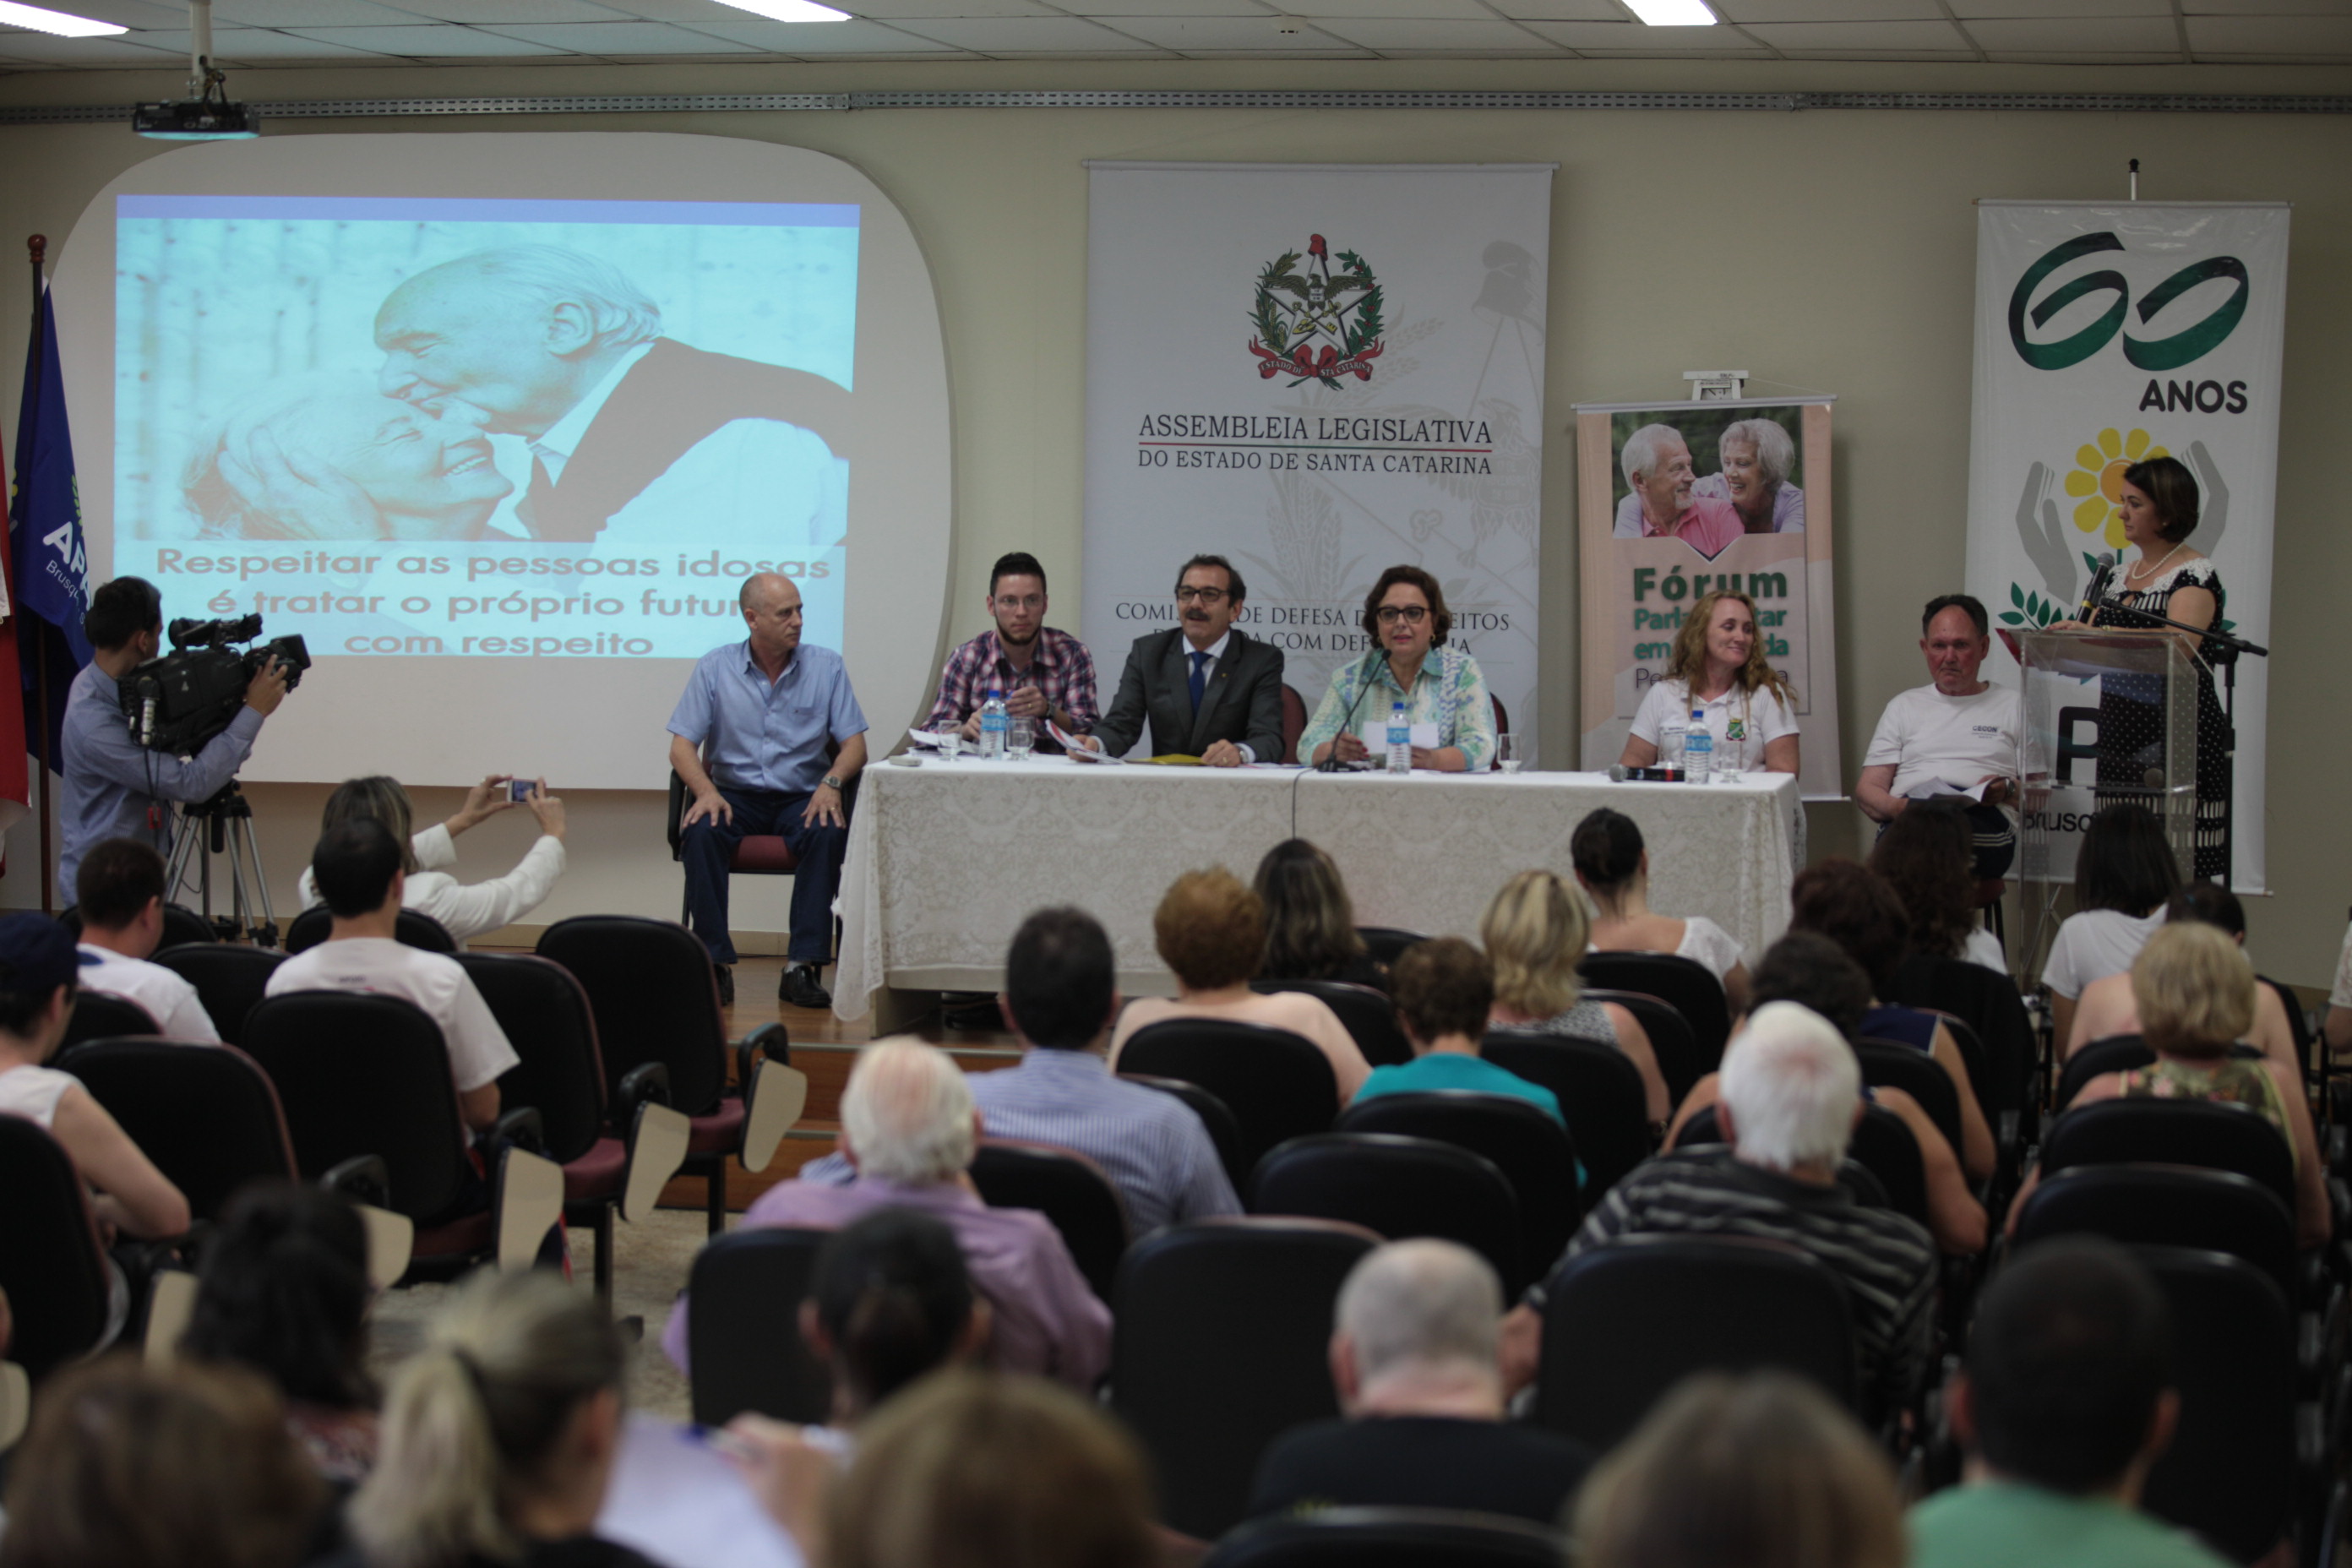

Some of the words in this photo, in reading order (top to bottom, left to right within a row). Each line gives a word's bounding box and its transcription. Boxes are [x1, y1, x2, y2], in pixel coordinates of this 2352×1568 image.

[2138, 378, 2247, 414] ANOS
[1139, 414, 1309, 439] ASSEMBLEIA
[1318, 417, 1492, 444] LEGISLATIVA
[1138, 449, 1168, 467] DO
[1176, 450, 1261, 469] ESTADO
[1270, 452, 1298, 470] DE
[1306, 453, 1375, 471] SANTA
[1383, 455, 1492, 475] CATARINA
[157, 548, 381, 581] Respeitar
[396, 556, 451, 574] as
[467, 554, 660, 581] pessoas
[678, 549, 830, 579] idosas
[1634, 565, 1787, 602] Fórum
[207, 590, 237, 613] é
[253, 591, 385, 613] tratar
[400, 596, 432, 614] o
[448, 591, 624, 622] próprio
[640, 589, 740, 617] futur
[1271, 607, 1346, 627] DEFESA
[344, 635, 443, 654] com
[462, 632, 654, 656] respeito
[1271, 633, 1322, 651] COM
